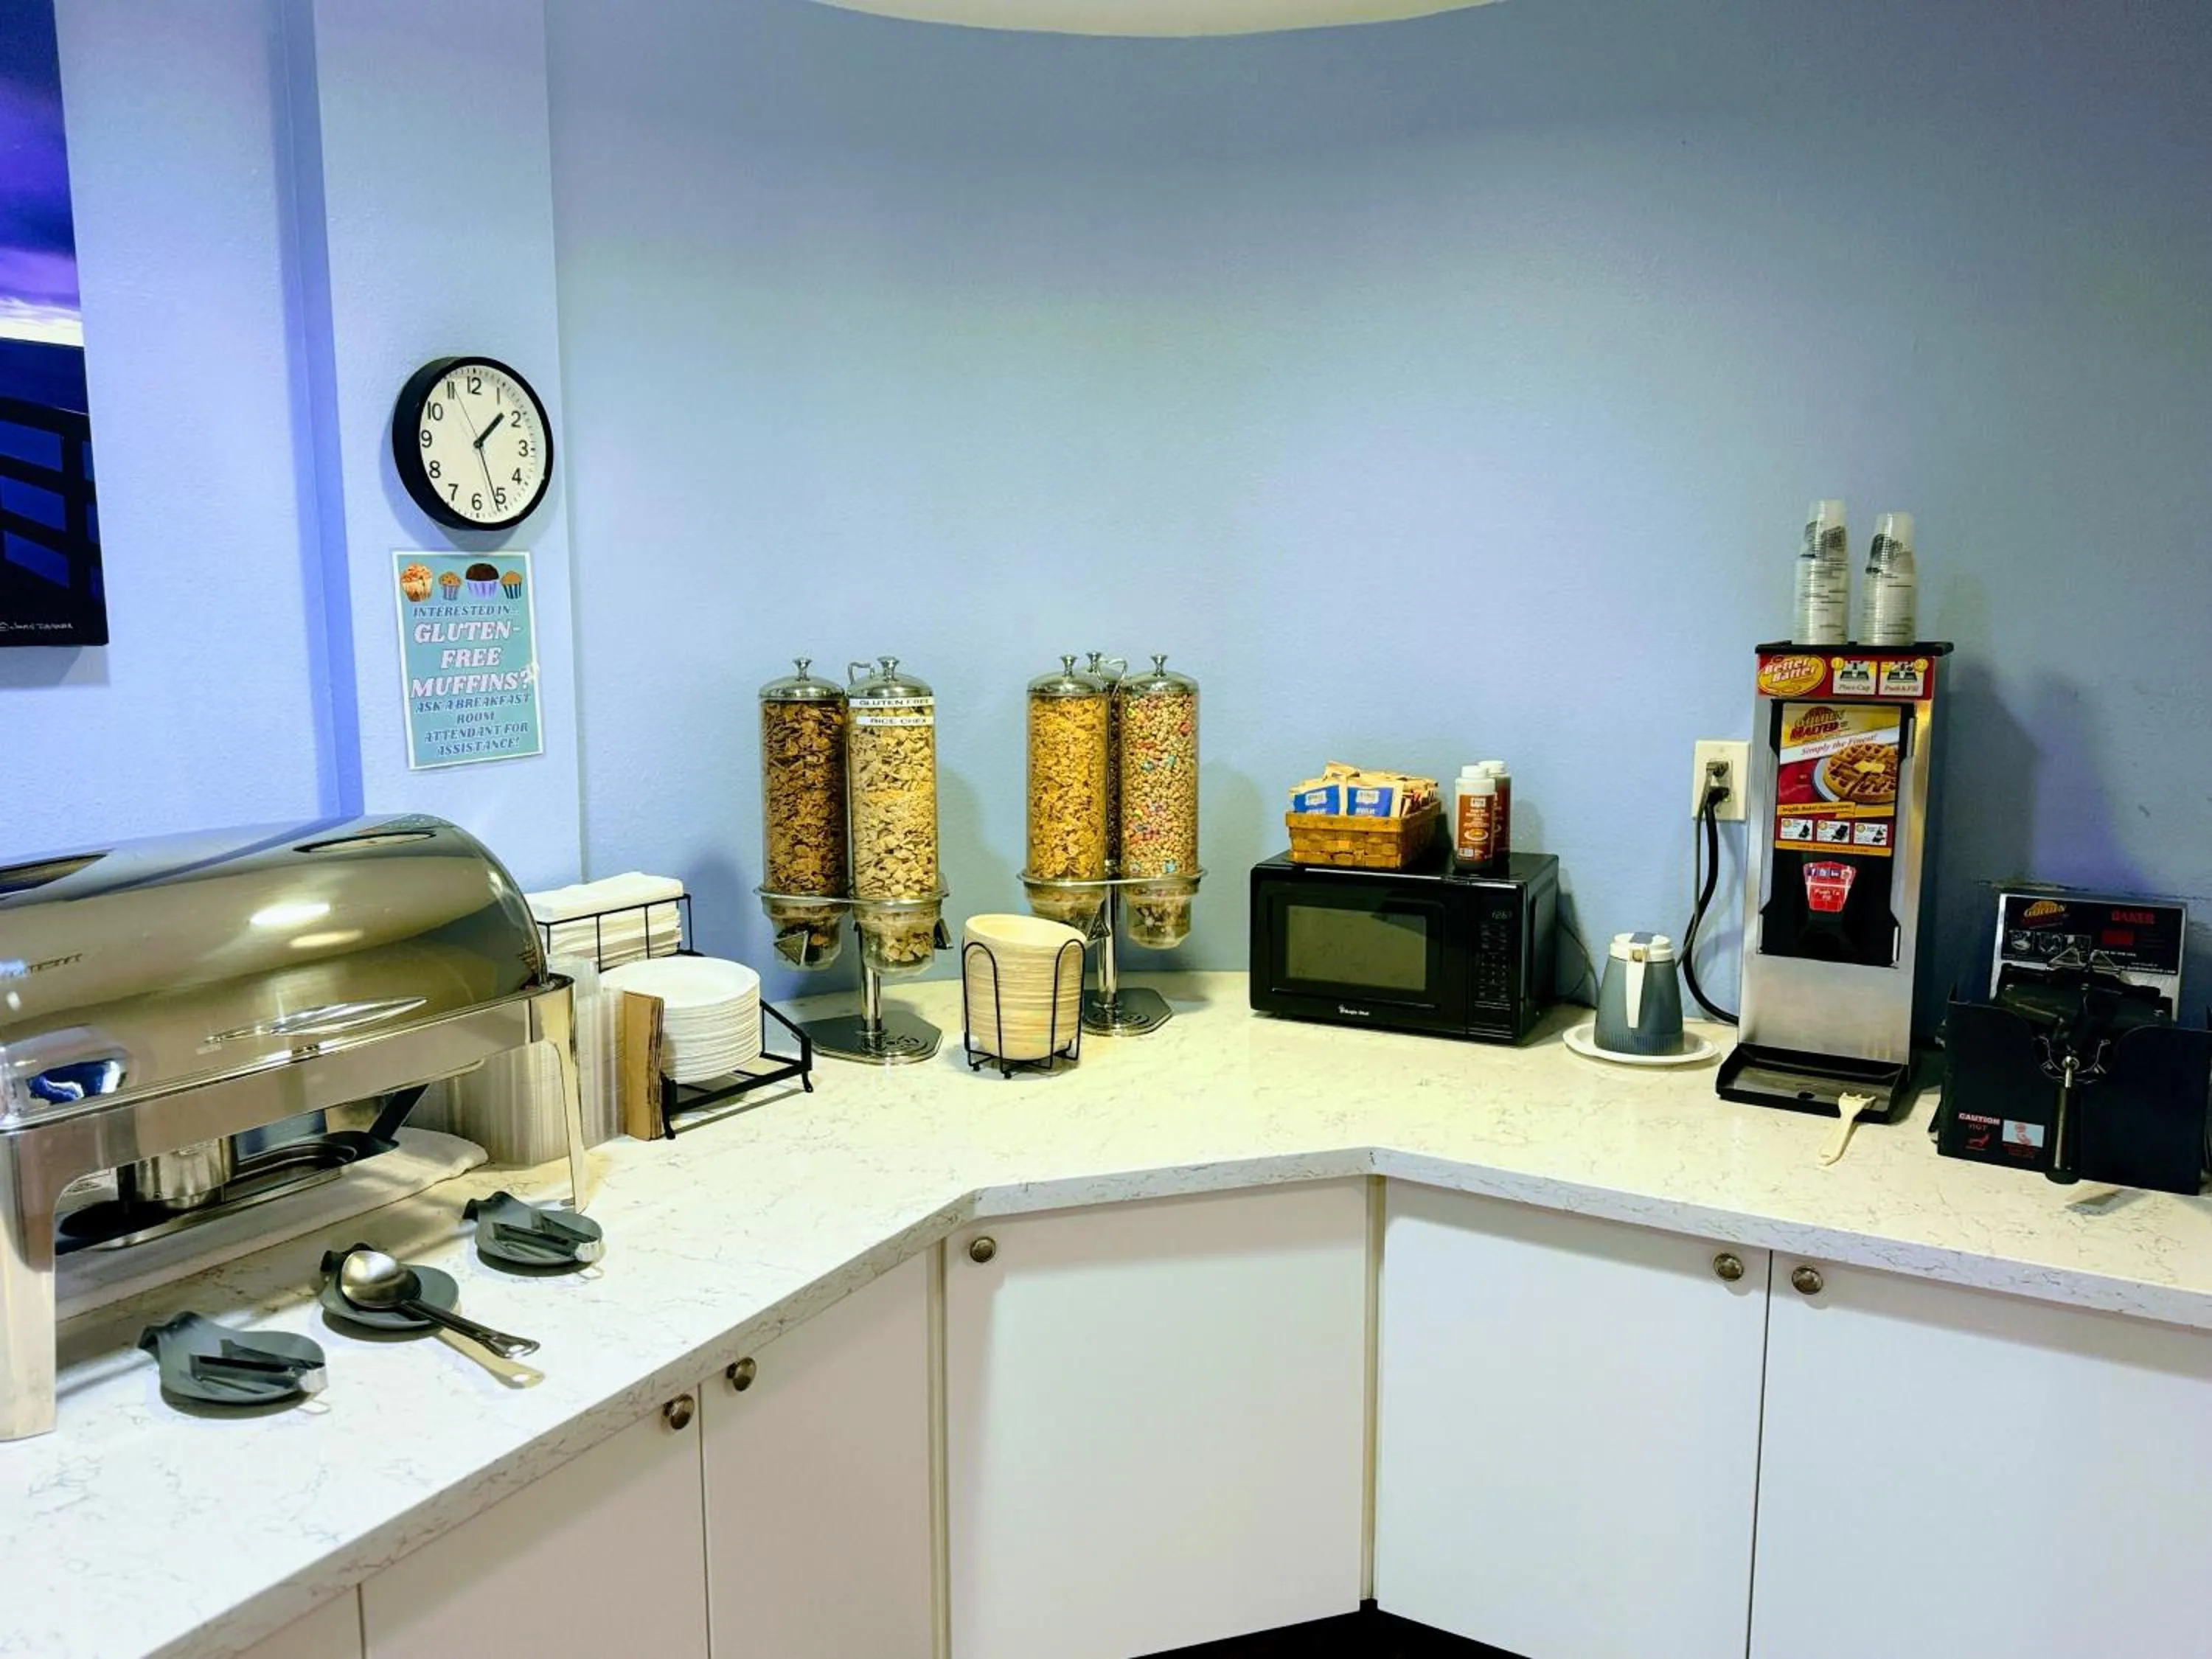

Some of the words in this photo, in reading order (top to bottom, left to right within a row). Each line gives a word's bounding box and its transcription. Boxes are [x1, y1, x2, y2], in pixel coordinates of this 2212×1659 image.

[447, 381, 455, 400] 11
[467, 376, 481, 395] 12
[496, 387, 501, 405] 1
[427, 401, 443, 421] 10
[510, 410, 521, 428] 2
[421, 430, 433, 448] 9
[518, 440, 529, 457] 3
[429, 460, 441, 479] 8
[511, 467, 522, 485] 4
[448, 484, 459, 501] 7
[495, 487, 507, 505] 5
[471, 493, 482, 511] 6
[413, 605, 495, 617] INTERESTED
[414, 622, 521, 643] GLUTEN-
[440, 647, 502, 669] FREE
[411, 669, 531, 698] MUFFINS?
[415, 702, 442, 713] ASK
[445, 701, 455, 711] A
[456, 694, 530, 709] BREAKFAST
[456, 712, 495, 724] ROOM
[424, 725, 502, 743] ATTENDANT
[504, 721, 529, 734] FOR
[437, 737, 520, 756] ASSISTANCE!
[1801, 742, 1830, 756] Simply
[1832, 739, 1846, 748] the
[2111, 910, 2155, 925] BAKER
[1958, 1113, 2000, 1125] CAUTION
